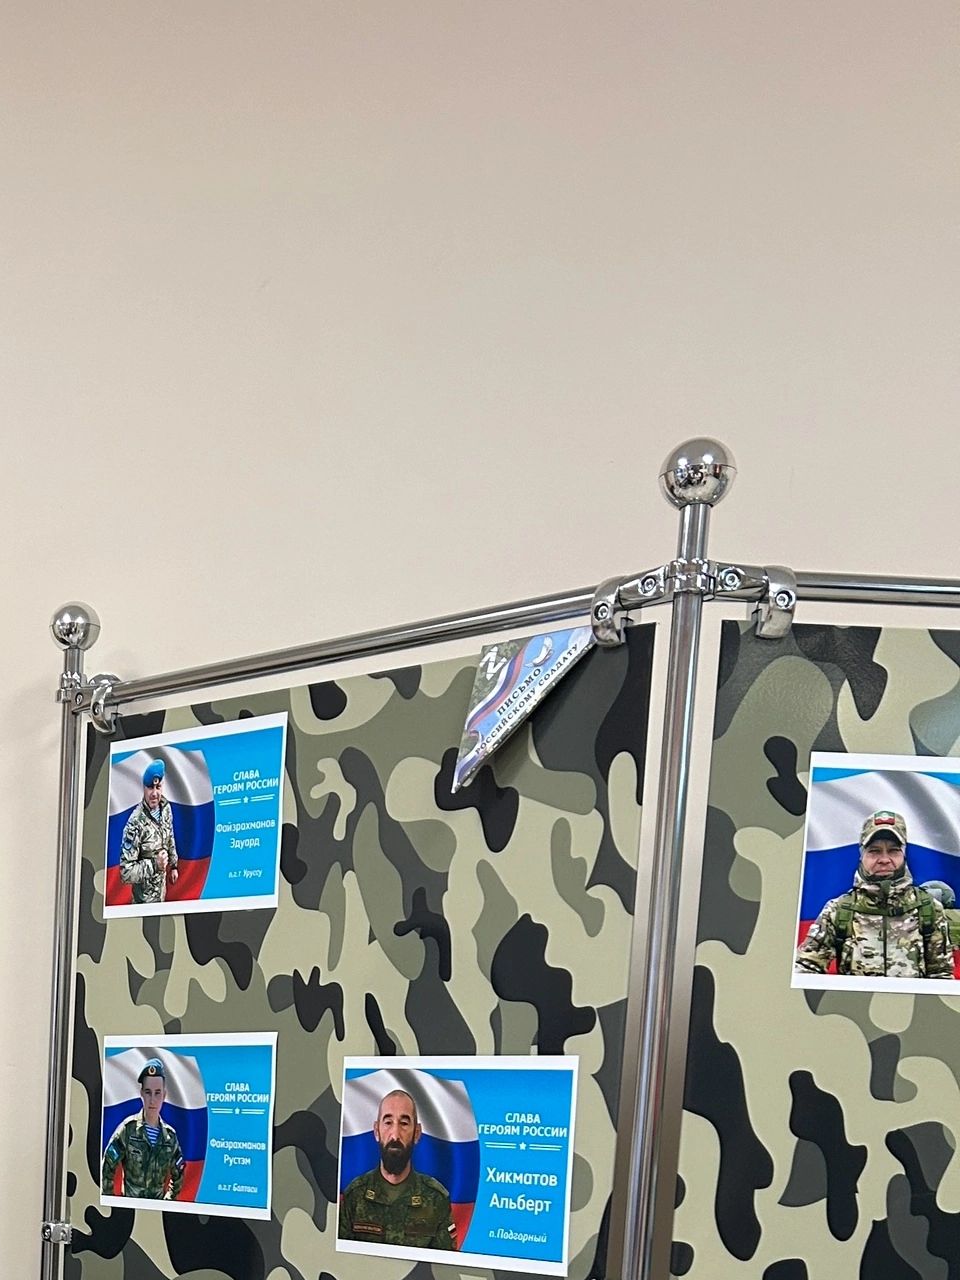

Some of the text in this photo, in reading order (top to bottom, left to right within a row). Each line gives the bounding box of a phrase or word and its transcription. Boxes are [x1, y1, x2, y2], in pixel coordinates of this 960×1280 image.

[497, 667, 541, 716] ПИСЬМО
[475, 643, 578, 755] РОССИЙСКОМУ СОЛДАТУ
[233, 769, 260, 781] СЛАВА
[213, 777, 279, 795] ГЕРОЯМ РОССИИ
[229, 838, 260, 850] Эдуард
[225, 1082, 250, 1092] СЛАВА
[206, 1093, 269, 1103] ГЕРОЯМ РОССИИ
[505, 1112, 541, 1124] СЛАВА
[478, 1124, 568, 1138] ГЕРОЯМ РОССИИ
[209, 1138, 267, 1151] Файзрахманов
[223, 1153, 251, 1167] Рустэм
[486, 1167, 558, 1187] Хикматов
[489, 1192, 552, 1216] Альберт
